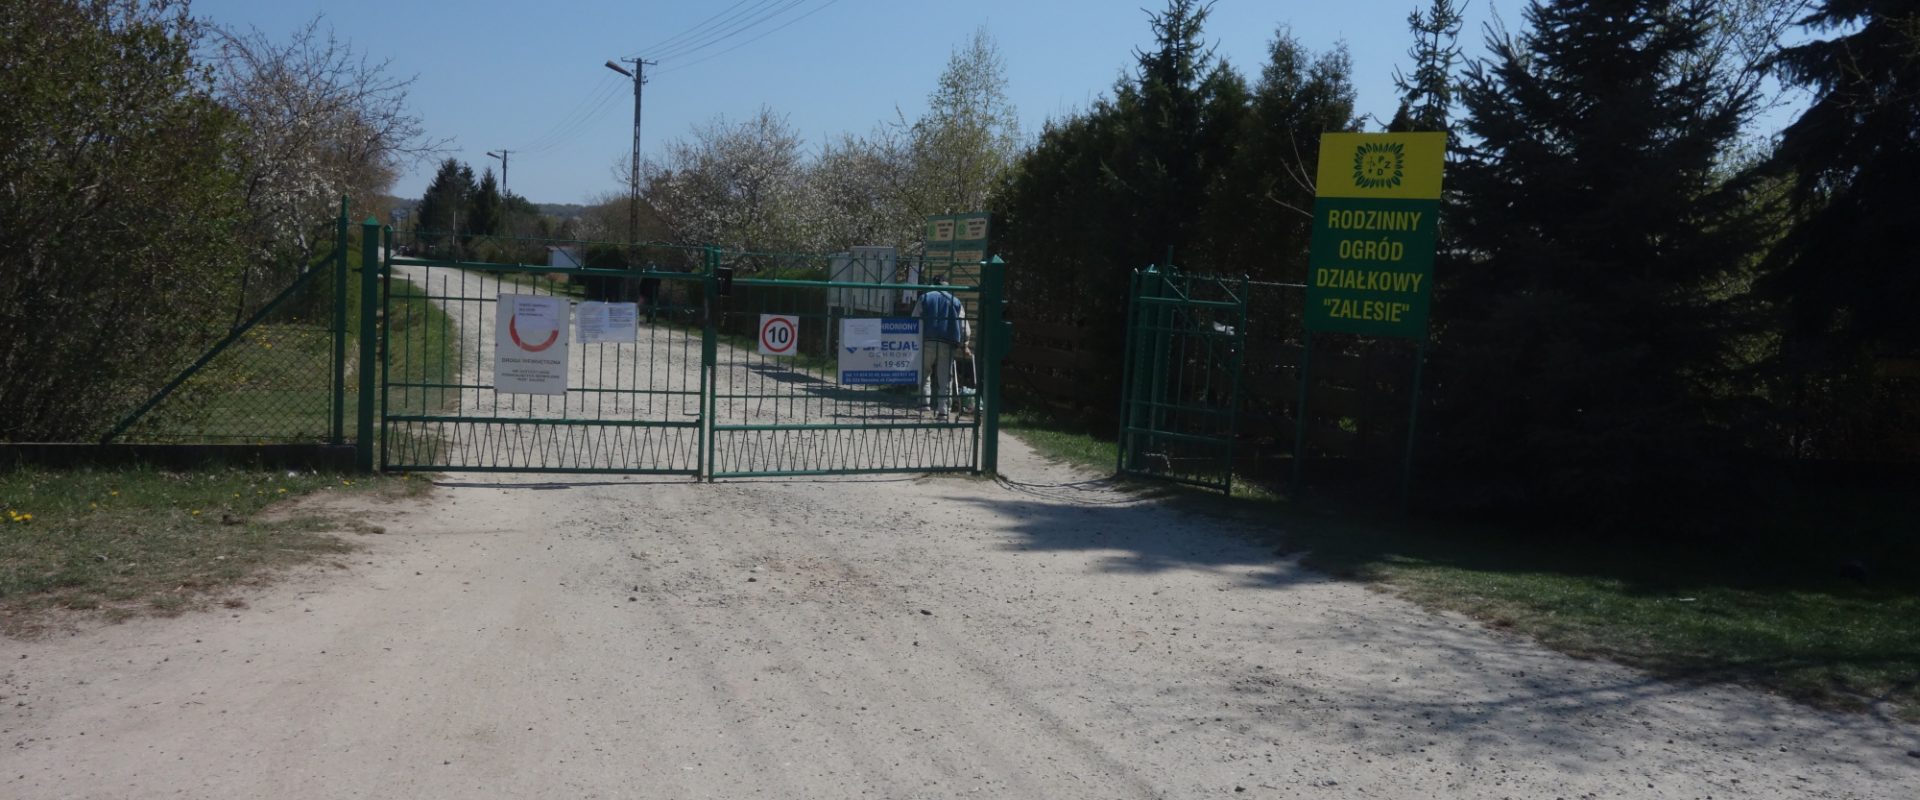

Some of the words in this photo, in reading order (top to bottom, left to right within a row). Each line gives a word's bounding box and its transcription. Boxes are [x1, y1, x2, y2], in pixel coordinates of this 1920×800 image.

[1328, 210, 1422, 231] RODZINNY
[1339, 237, 1403, 261] OGRÓD
[1316, 268, 1423, 293] DZIAŁKOWY
[1323, 298, 1410, 322] "ZALESIE"
[768, 326, 788, 344] 10
[881, 322, 917, 331] HRONIONY
